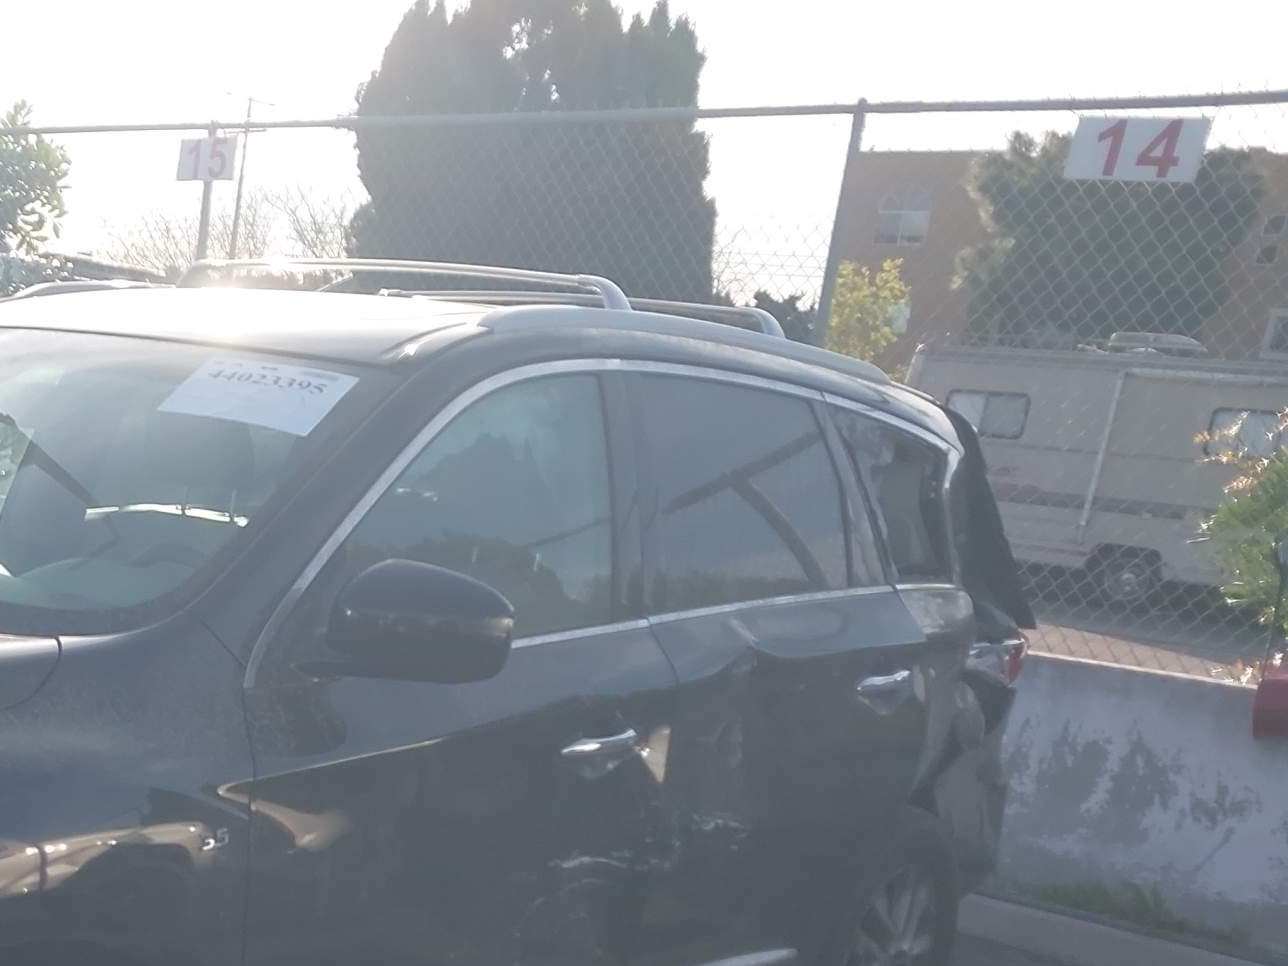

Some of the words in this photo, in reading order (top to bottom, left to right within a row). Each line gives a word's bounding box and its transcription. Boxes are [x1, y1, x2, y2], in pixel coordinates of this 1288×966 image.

[188, 137, 227, 178] 15
[1098, 118, 1184, 178] 14
[208, 369, 328, 394] 44023395
